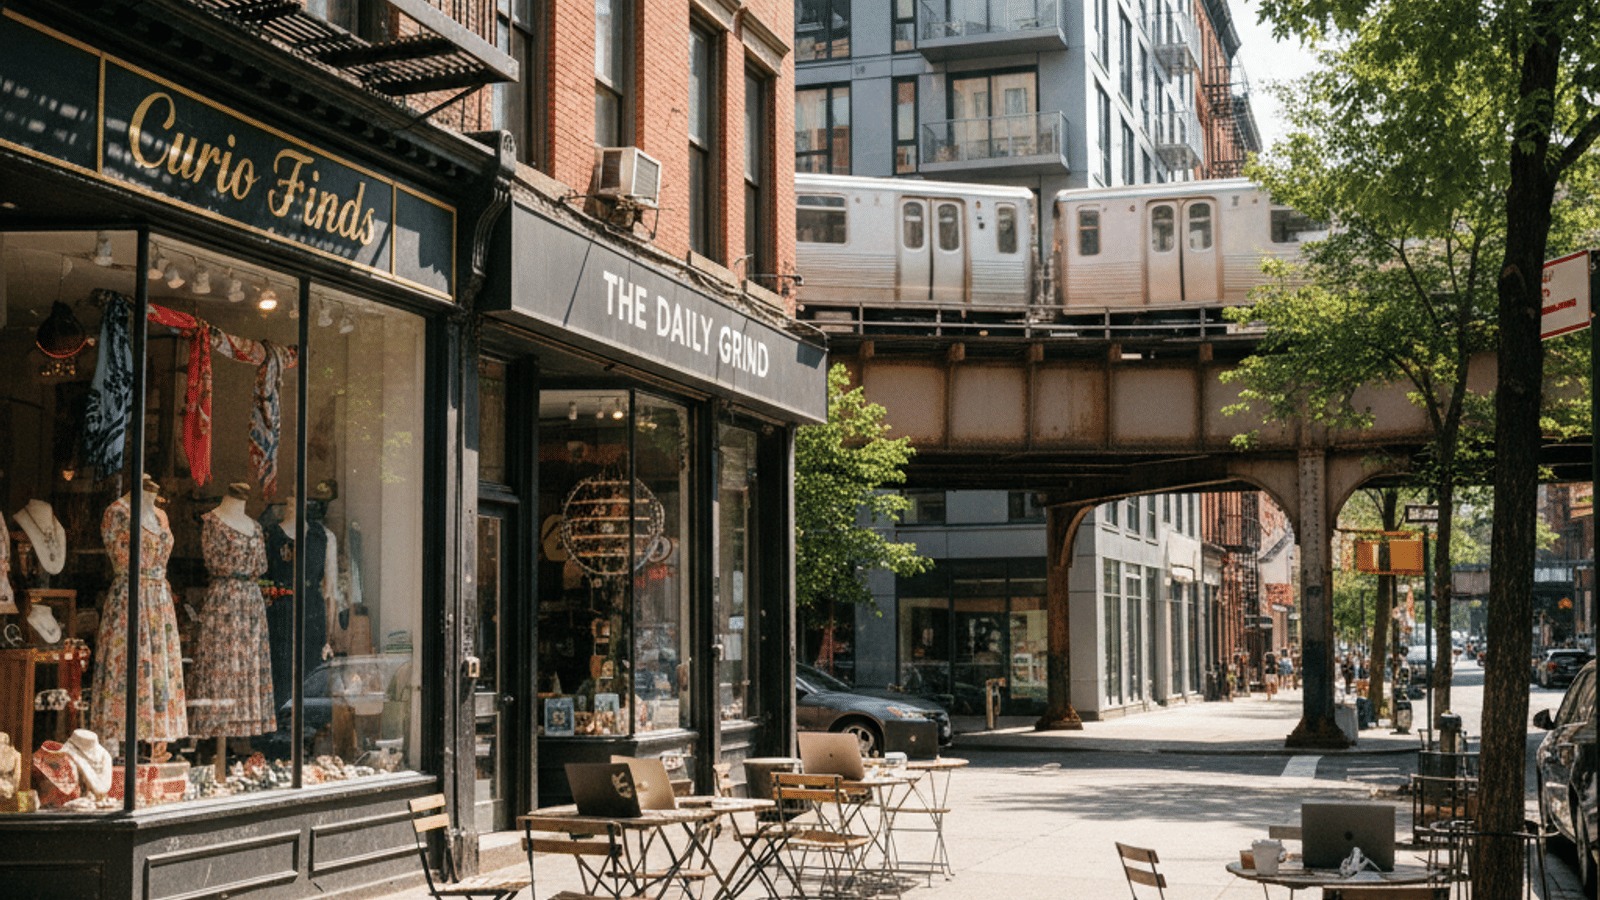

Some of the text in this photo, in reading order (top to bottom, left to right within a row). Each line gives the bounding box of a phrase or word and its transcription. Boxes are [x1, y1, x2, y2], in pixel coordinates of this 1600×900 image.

[129, 92, 375, 246] Curio Finds
[603, 270, 769, 378] THE DAILY GRIND
